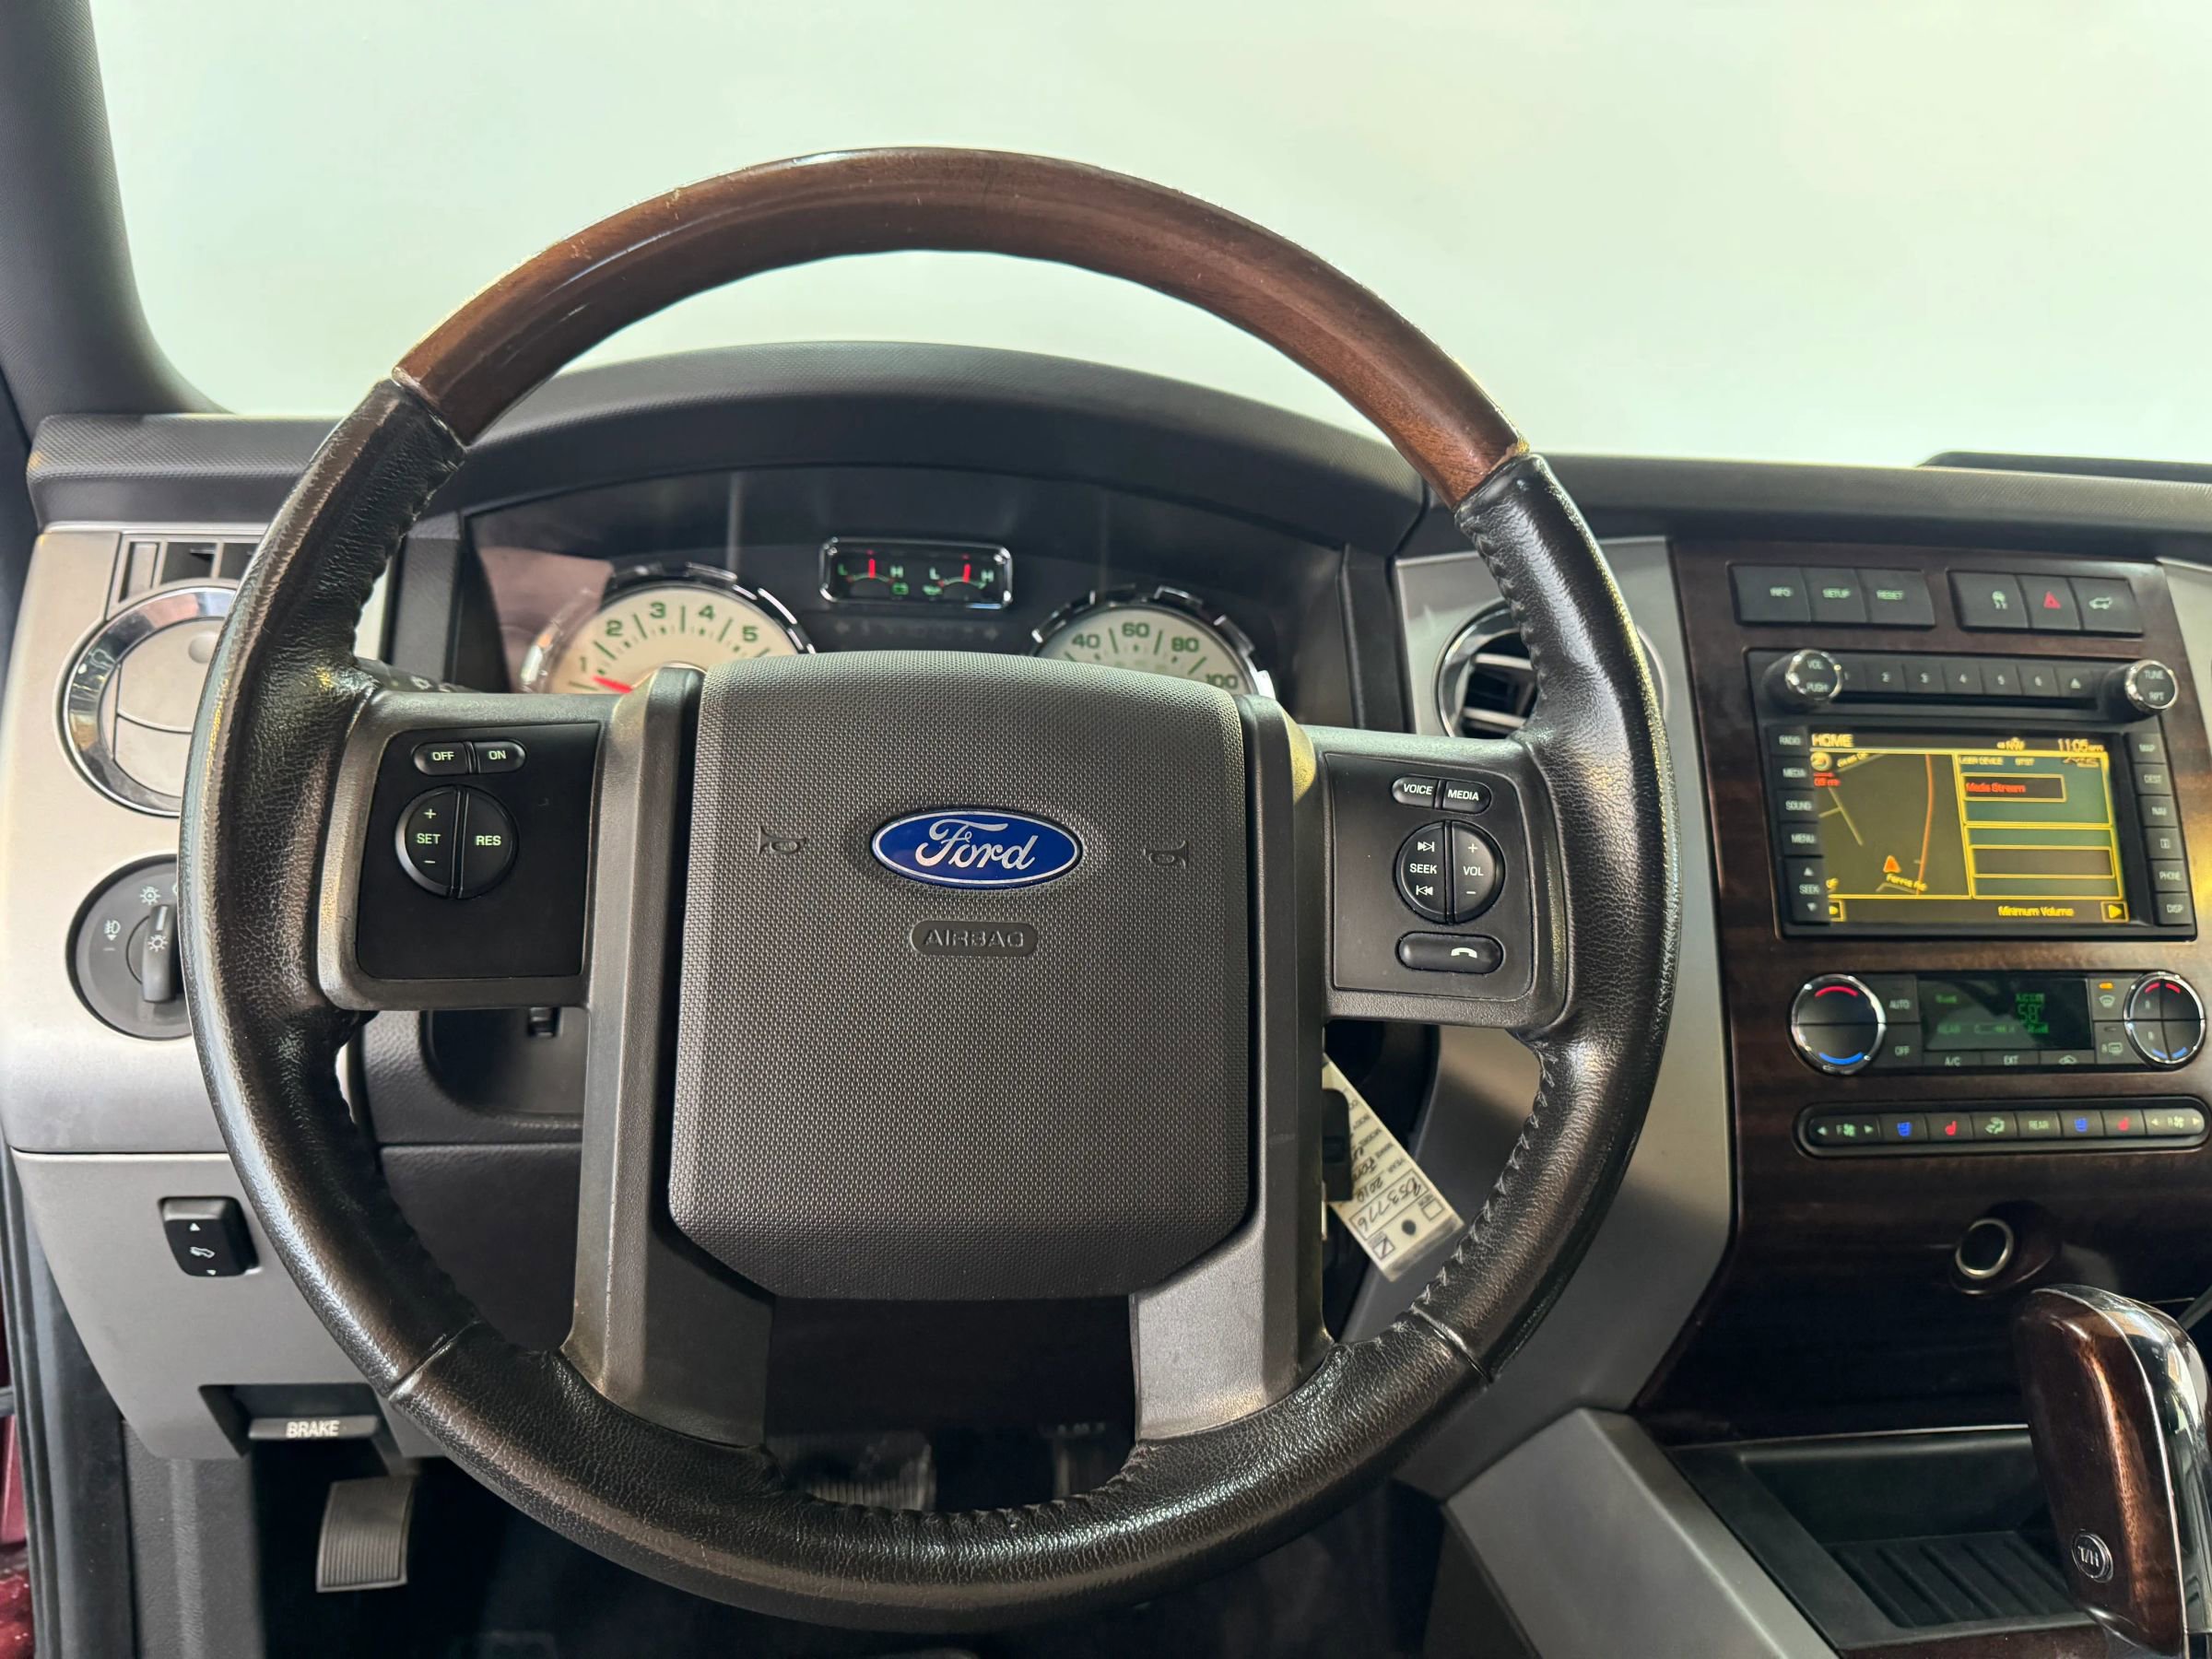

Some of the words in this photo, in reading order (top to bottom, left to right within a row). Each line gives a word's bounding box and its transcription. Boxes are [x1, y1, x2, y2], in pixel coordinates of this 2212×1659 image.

[838, 564, 848, 576] L
[889, 565, 904, 578] H
[929, 567, 940, 580] L
[981, 570, 994, 582] H
[1822, 588, 1851, 599] SETUP
[1877, 590, 1904, 600] RESET
[650, 602, 666, 618] 3
[699, 605, 715, 620] 4
[605, 619, 623, 637] 2
[742, 626, 759, 641] 5
[1122, 622, 1149, 638] 60
[1072, 634, 1100, 649] 40
[1171, 637, 1199, 653] 80
[580, 656, 587, 672] 1
[1807, 660, 1824, 670] VOL
[1881, 671, 1890, 683] 2
[2144, 670, 2164, 680] TUNE
[1206, 674, 1238, 689] 100
[1806, 681, 1829, 692] PUSH
[1779, 735, 1801, 746] RADIO
[1811, 733, 1853, 747] HOME
[432, 751, 454, 761] OFF
[488, 750, 506, 760] ON
[1783, 768, 1806, 778] MEDIA
[1403, 783, 1433, 795] VOICE
[1991, 782, 2026, 793] Stream
[1448, 789, 1479, 801] MEDIA
[1785, 801, 1812, 811] SOUND
[417, 833, 441, 844] SET
[476, 835, 501, 846] RES
[1791, 833, 1817, 843] MENU
[915, 818, 1039, 870] Ford
[1410, 864, 1437, 875] SEEK
[1464, 865, 1484, 877] VOL
[2159, 871, 2182, 881] PHONE
[1799, 884, 1820, 895] SEEK
[1998, 906, 2039, 917] Minimum
[2040, 906, 2074, 917] Volume
[2166, 904, 2183, 913] DISP
[924, 928, 1025, 948] AIRBAG
[1889, 999, 1910, 1009] AUTO
[1895, 1046, 1910, 1055] OFF
[1945, 1057, 1961, 1066] A/C
[2029, 1120, 2050, 1130] REAR
[286, 1420, 340, 1439] BRAKE
